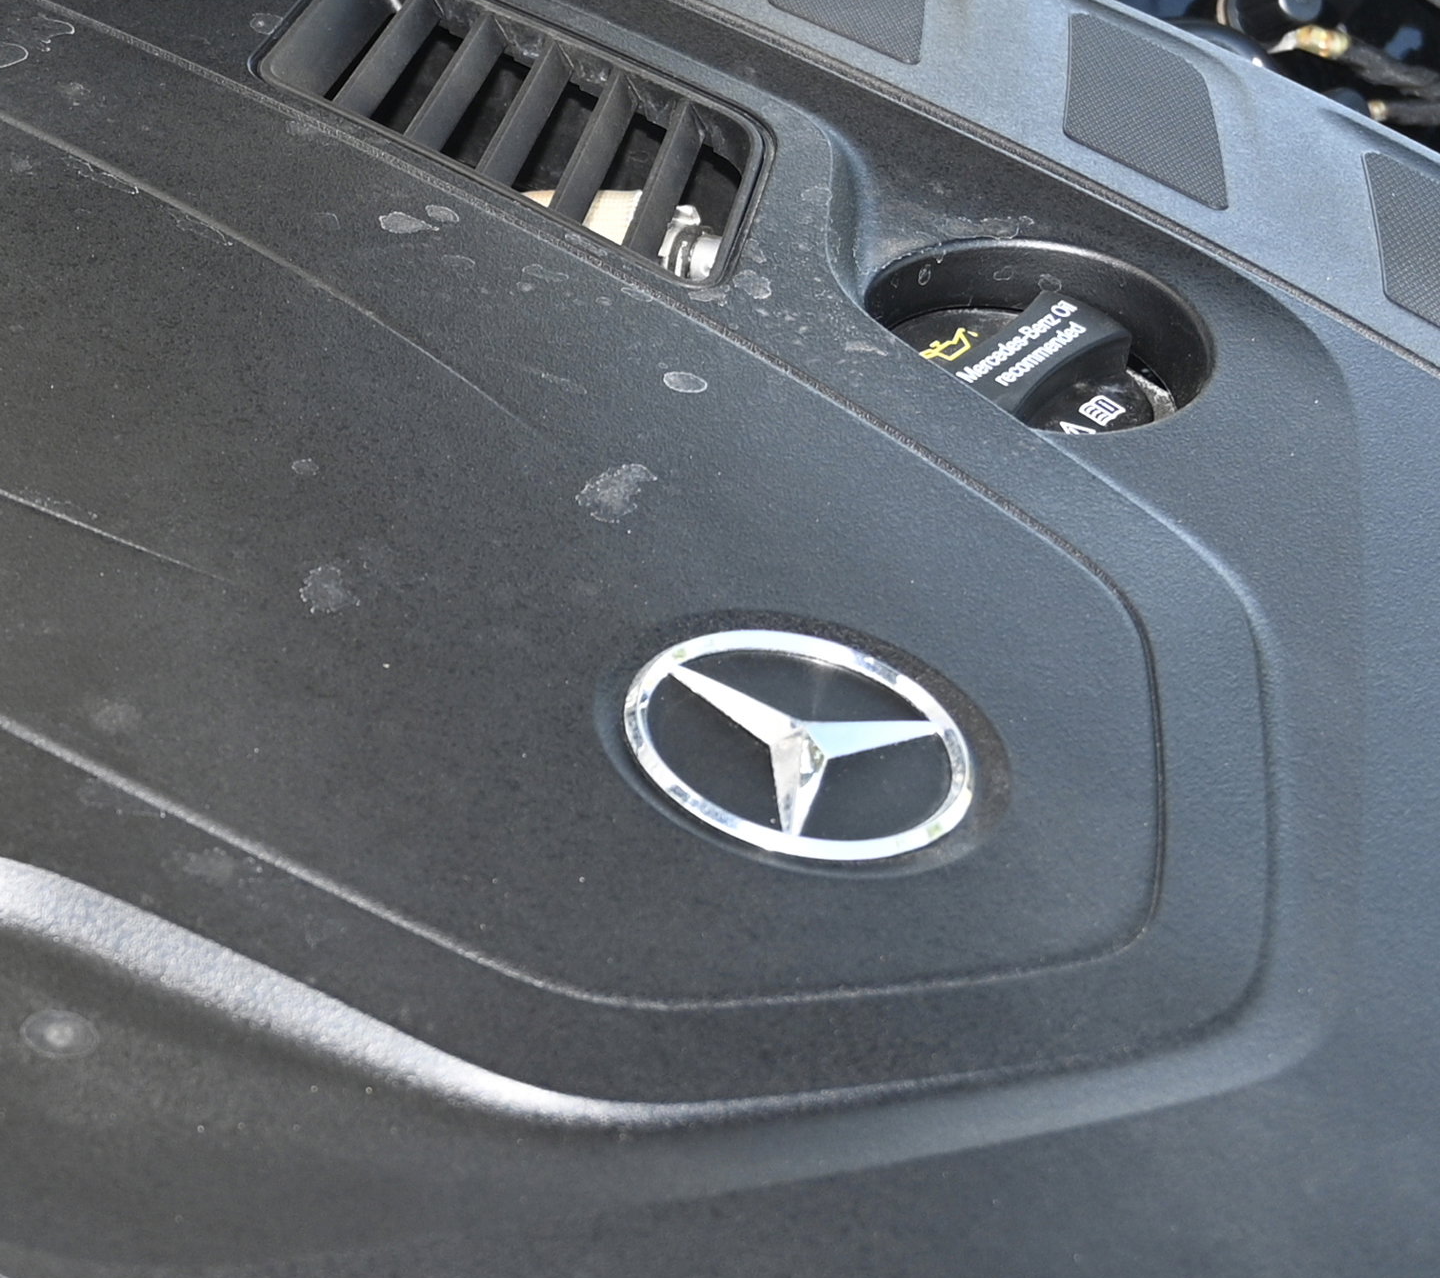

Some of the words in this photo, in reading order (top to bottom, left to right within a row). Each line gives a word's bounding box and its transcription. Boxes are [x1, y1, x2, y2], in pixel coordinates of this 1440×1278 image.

[956, 313, 1062, 383] Mercedes-Benz
[1050, 299, 1079, 320] Oil
[994, 321, 1087, 387] recommended
